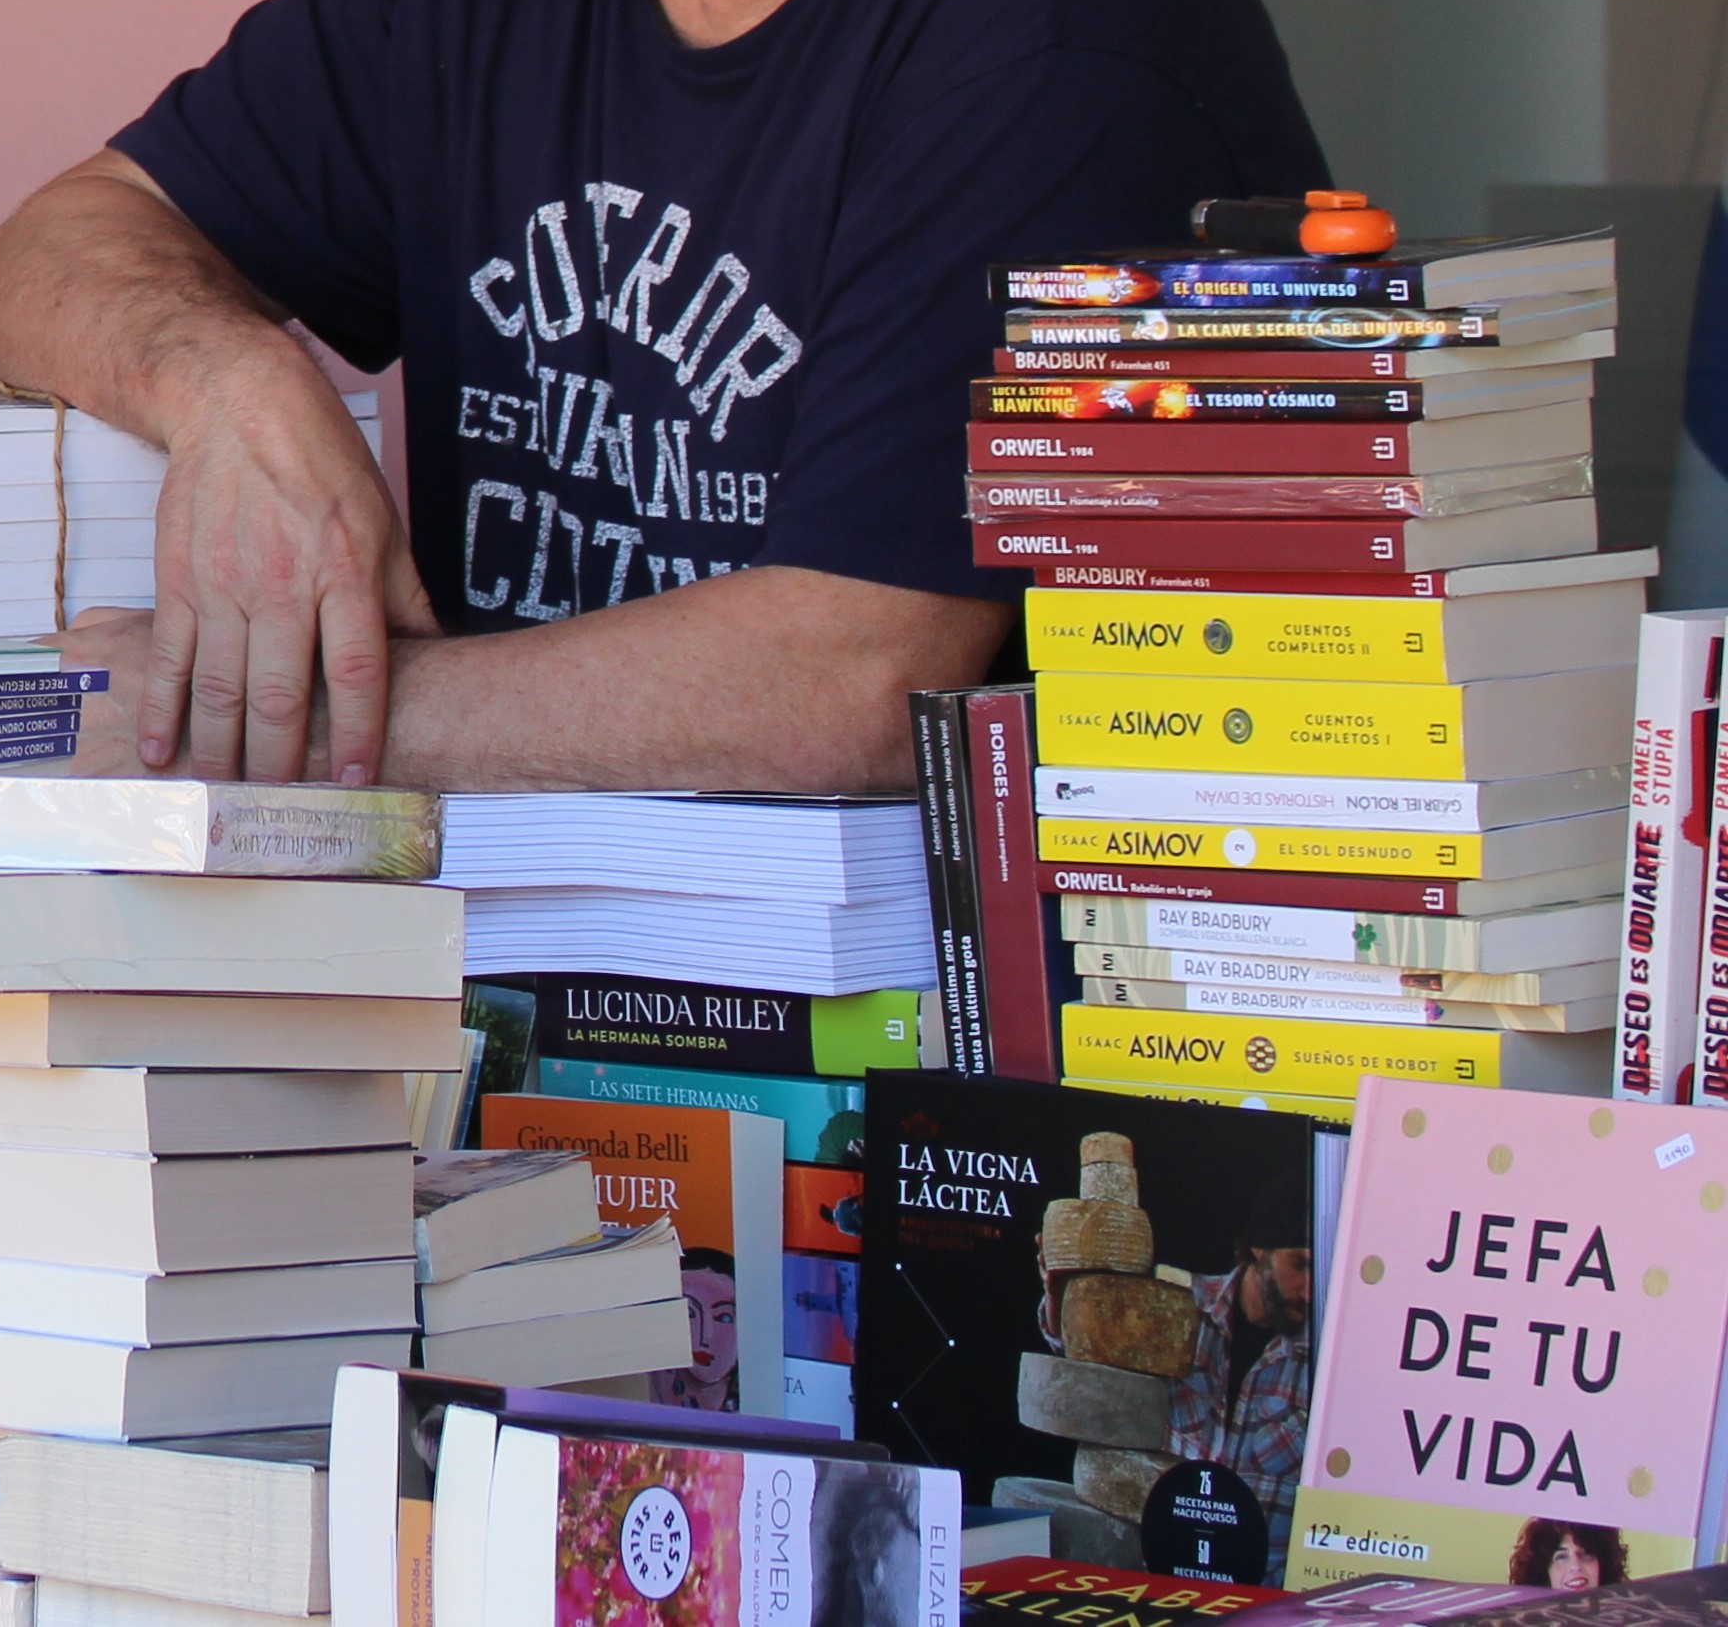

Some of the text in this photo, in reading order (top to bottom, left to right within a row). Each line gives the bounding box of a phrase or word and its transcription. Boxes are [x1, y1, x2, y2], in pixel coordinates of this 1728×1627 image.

[1008, 282, 1088, 299] HAWKING
[1173, 281, 1357, 297] EL ORIGEN DEL UNIVERSO
[1031, 328, 1121, 344] HAWKING
[1178, 323, 1325, 338] LA CLAVE SECRETA
[1015, 351, 1107, 370] BRADBURY
[1206, 390, 1336, 407] TESORO CÓSMICO
[991, 439, 1093, 457] ORWELL 1984
[695, 470, 779, 526] 198
[988, 488, 1066, 506] ORWELL
[1043, 622, 1184, 651] ISAAC ASIMOV
[1283, 624, 1352, 638] CUENTOS
[1267, 640, 1355, 655] COMPLETOS
[989, 723, 1009, 798] BORGES
[1632, 719, 1652, 807] PAMELA
[1653, 728, 1674, 805] STUPIA
[1401, 797, 1463, 813] GABRIEL
[1105, 831, 1412, 860] ASIMOV EL SOL DESNUDO
[1055, 871, 1129, 893] ORWELL
[1158, 908, 1272, 932] RAY BRADBURY
[1622, 822, 1661, 1095] DESEO ES ODIARTE
[961, 935, 980, 1036] la última gota
[566, 989, 791, 1031] LUCINDA RILEY
[567, 1029, 727, 1050] LA HERMANA SOMBRA
[1294, 1049, 1438, 1073] SUEÑOS ROBOT
[590, 1080, 759, 1112] LAS SIETE HERMANAS
[635, 1133, 689, 1163] Belli
[899, 1144, 1040, 1185] LA VIGNA
[898, 1174, 1013, 1218] LÁCTEA
[1426, 1210, 1616, 1294] JEFA
[1400, 1305, 1621, 1395] DE TU
[1401, 1409, 1588, 1498] VIDA
[1200, 1470, 1211, 1496] 25
[1173, 1507, 1237, 1525] HACER QUESOS
[1175, 1496, 1236, 1513] RECETAS PARA
[630, 1507, 651, 1580] SELLER
[663, 1510, 682, 1580] BEST
[769, 1469, 793, 1618] COMER,
[1346, 1534, 1425, 1561] edición
[1029, 1570, 1253, 1615] ISABE
